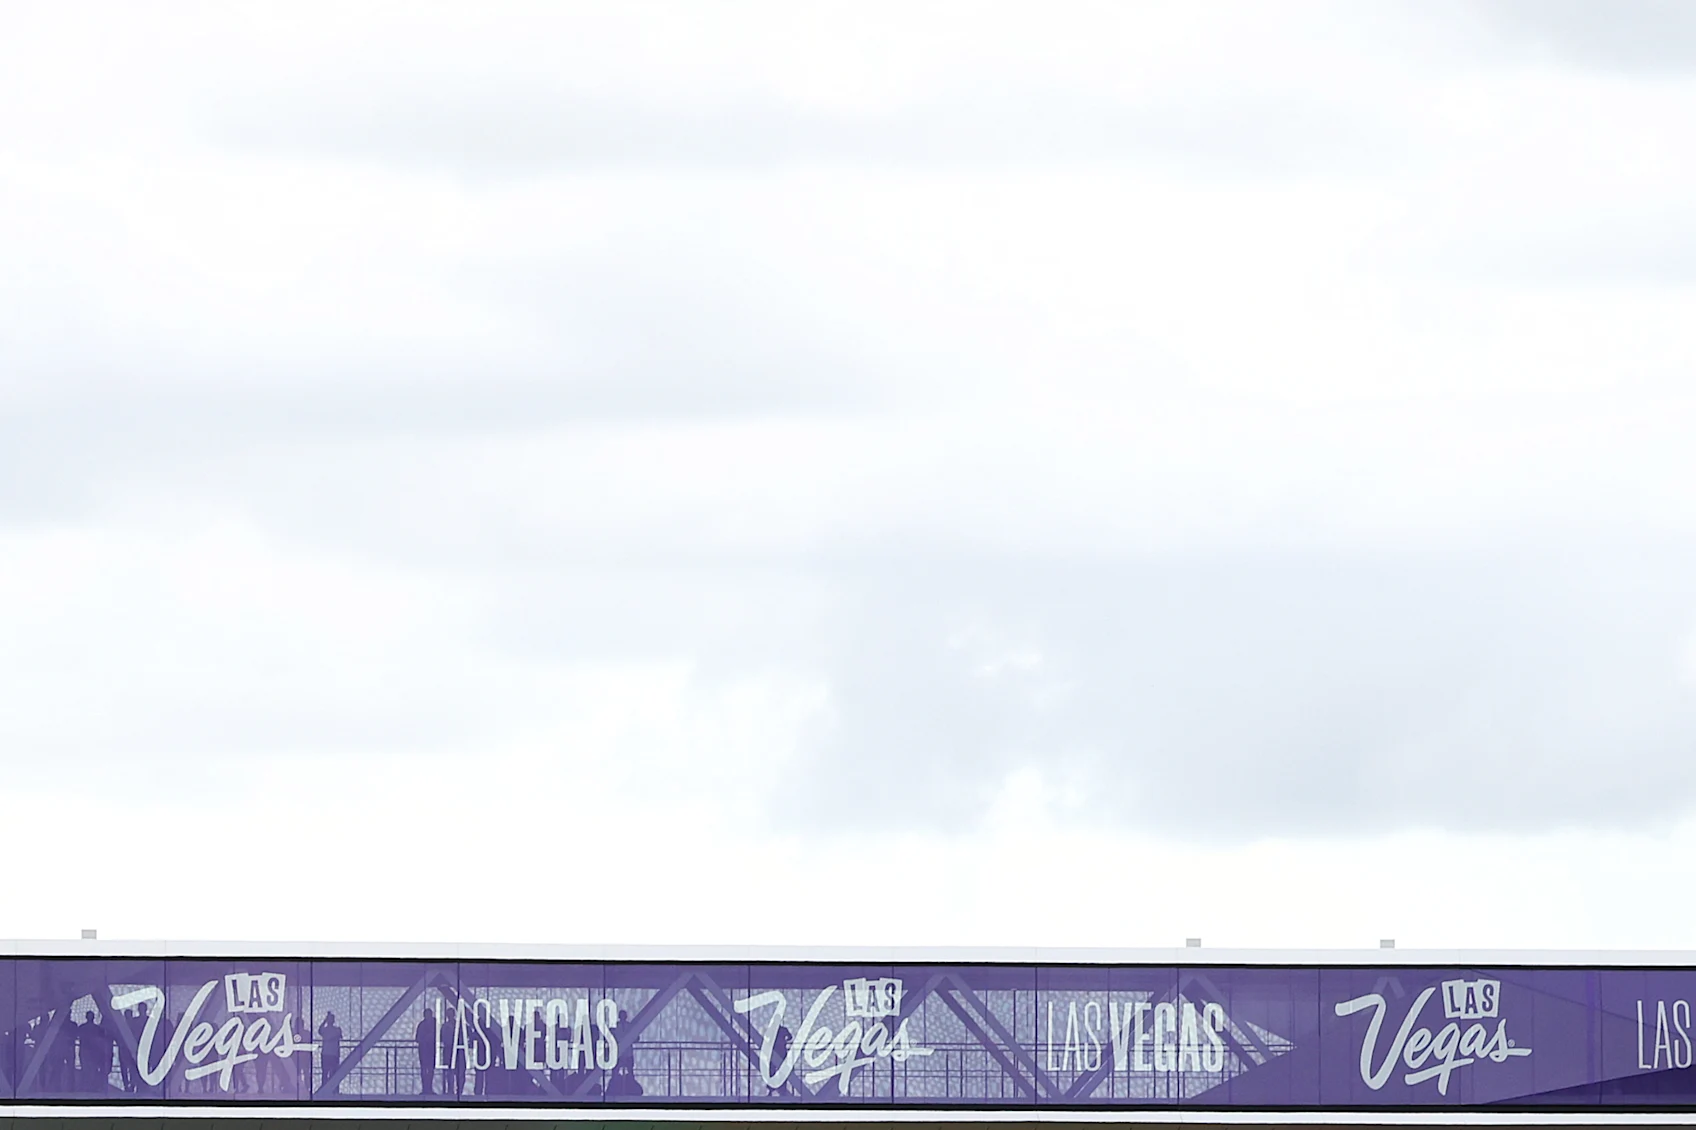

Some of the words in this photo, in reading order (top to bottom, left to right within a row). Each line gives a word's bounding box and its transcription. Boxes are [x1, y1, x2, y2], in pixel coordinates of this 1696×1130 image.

[230, 976, 282, 1009] LAS
[848, 981, 899, 1014] LAS
[1447, 983, 1497, 1016] LAS
[112, 980, 318, 1091] Vegas
[434, 997, 491, 1070] LAS
[500, 997, 619, 1071] VEGAS
[734, 984, 934, 1094] Vegas
[1046, 1001, 1101, 1072] LAS
[1108, 1001, 1224, 1072] VEGAS
[1335, 986, 1532, 1095] Vegas
[1637, 1000, 1692, 1069] LAS
